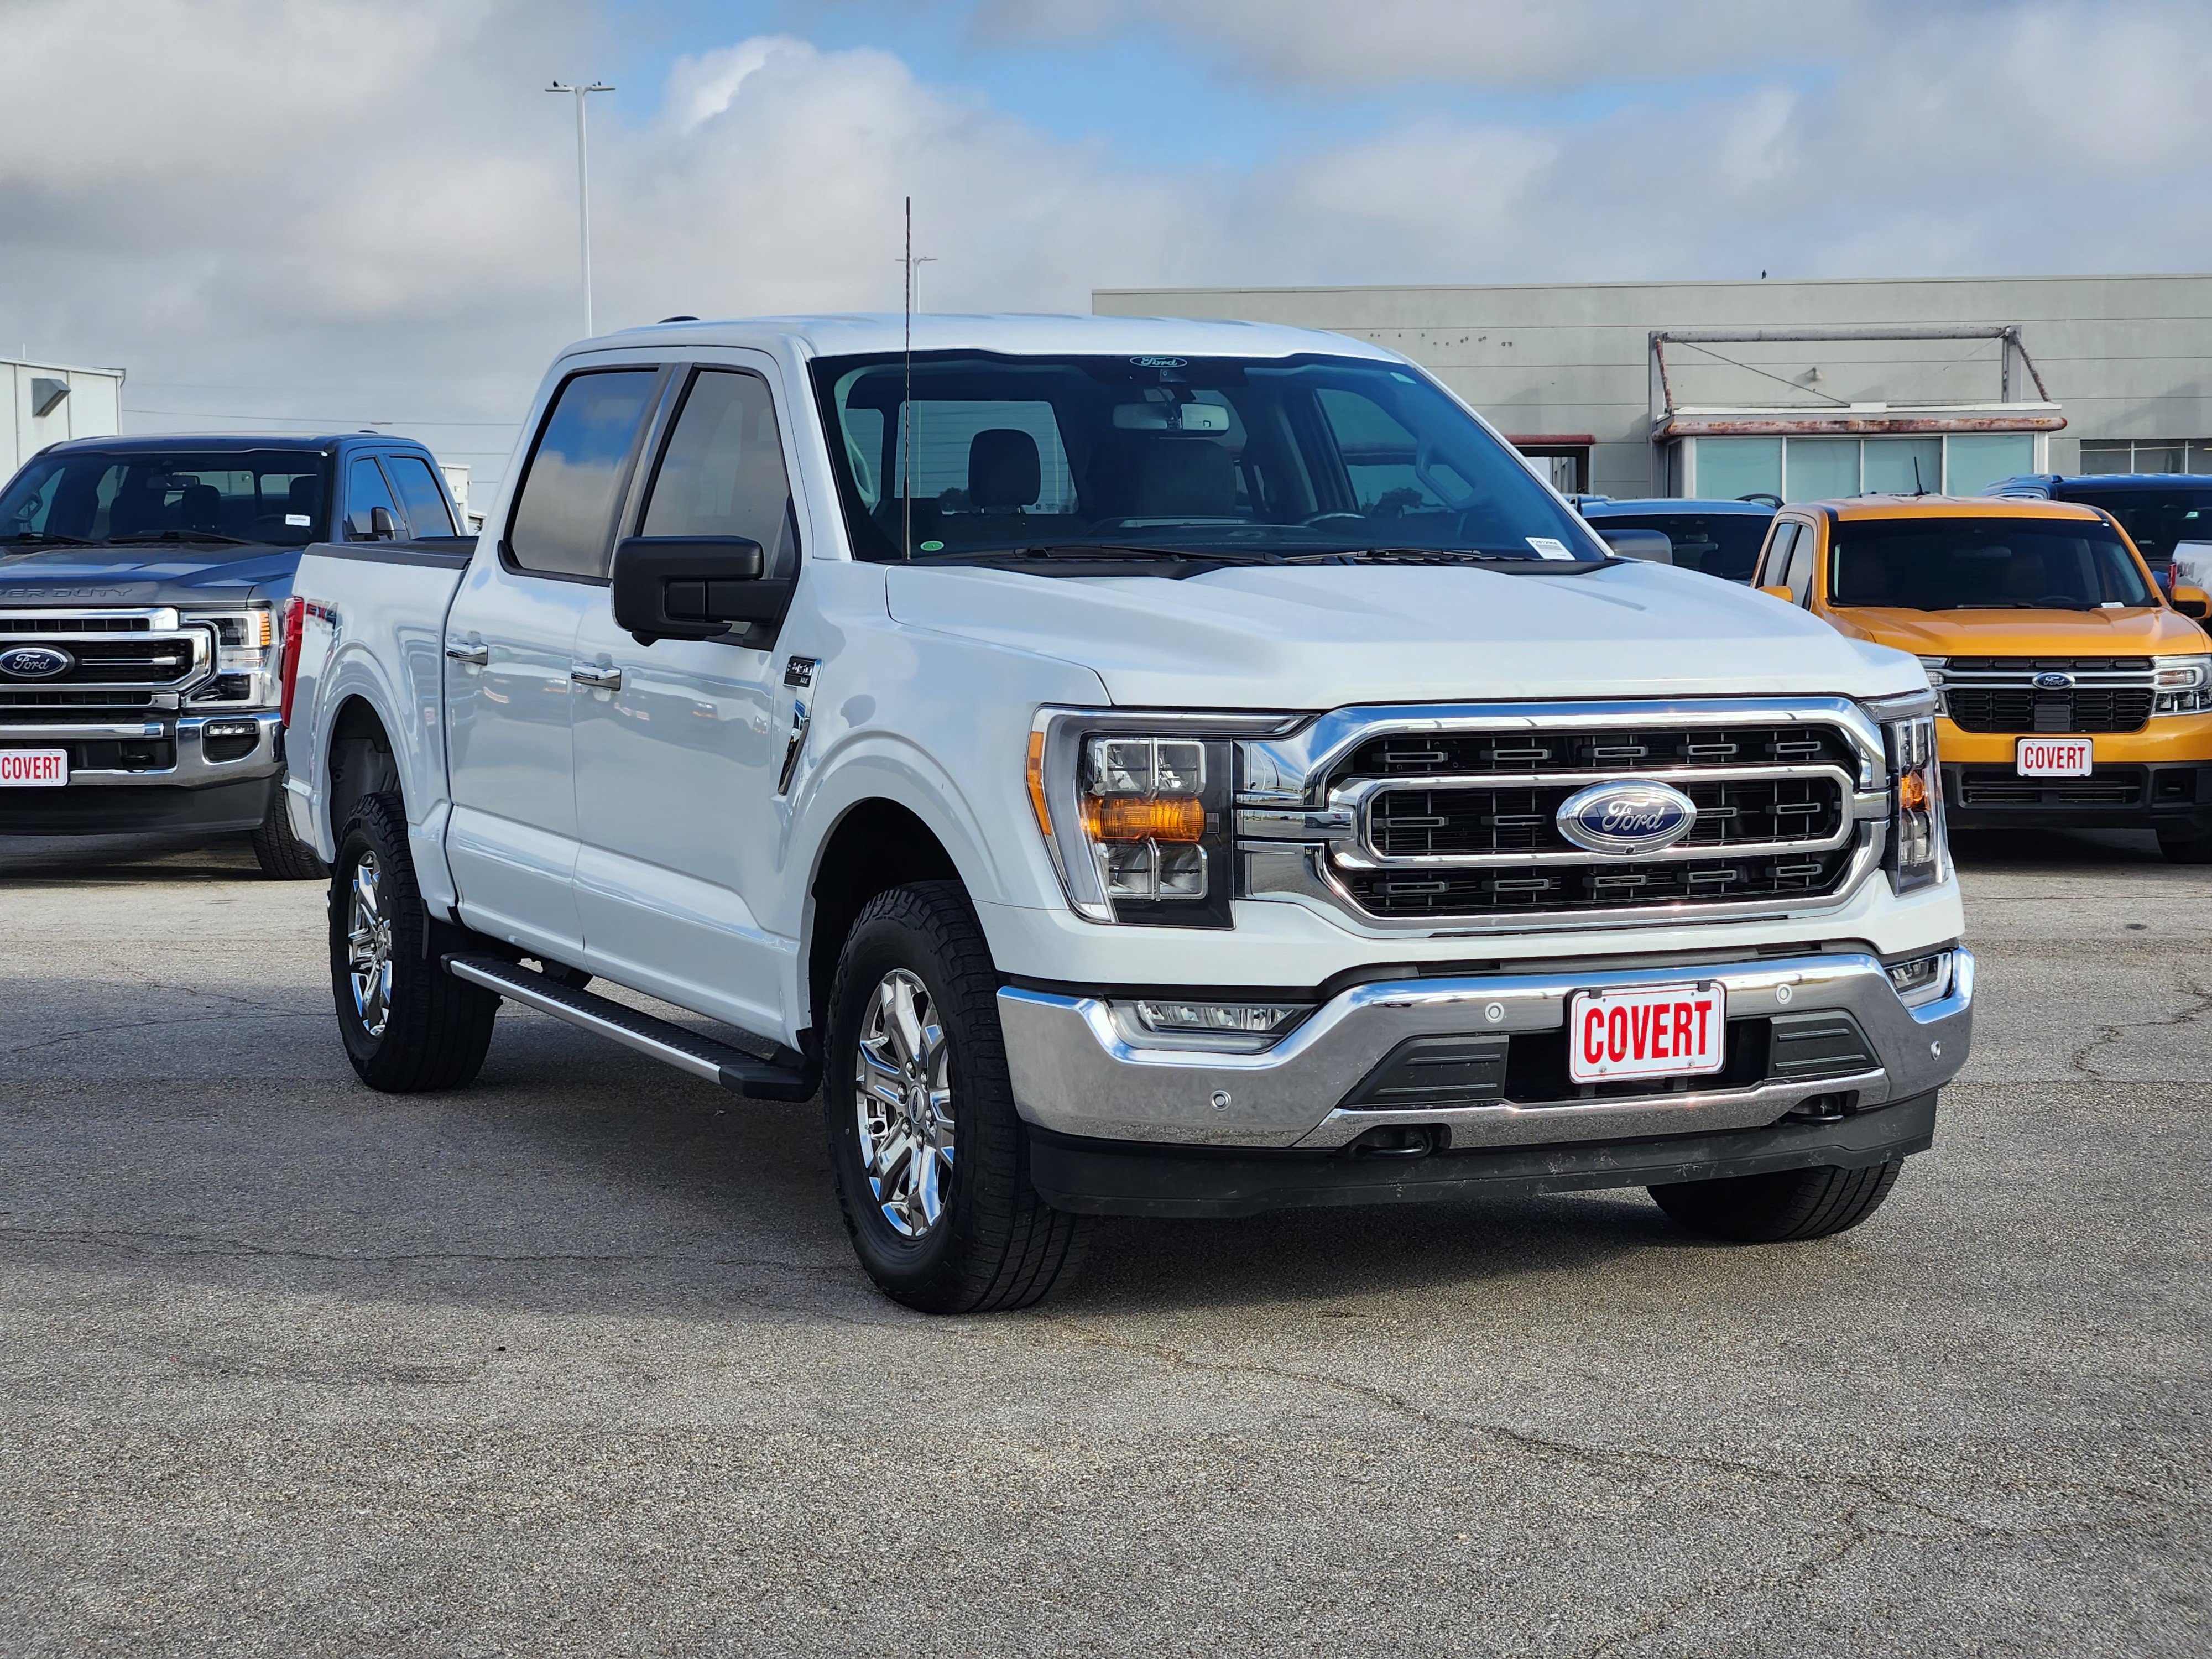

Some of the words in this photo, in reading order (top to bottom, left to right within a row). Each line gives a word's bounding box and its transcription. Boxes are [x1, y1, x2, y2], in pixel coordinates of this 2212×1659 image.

[1141, 356, 1178, 366] Ford
[51, 588, 132, 597] DUTY
[13, 654, 50, 670] Ford
[2043, 676, 2065, 685] Ford
[2025, 747, 2085, 769] COVERT
[2, 757, 61, 779] COVERT
[1601, 800, 1664, 832] Ford
[1584, 1000, 1712, 1064] COVERT
